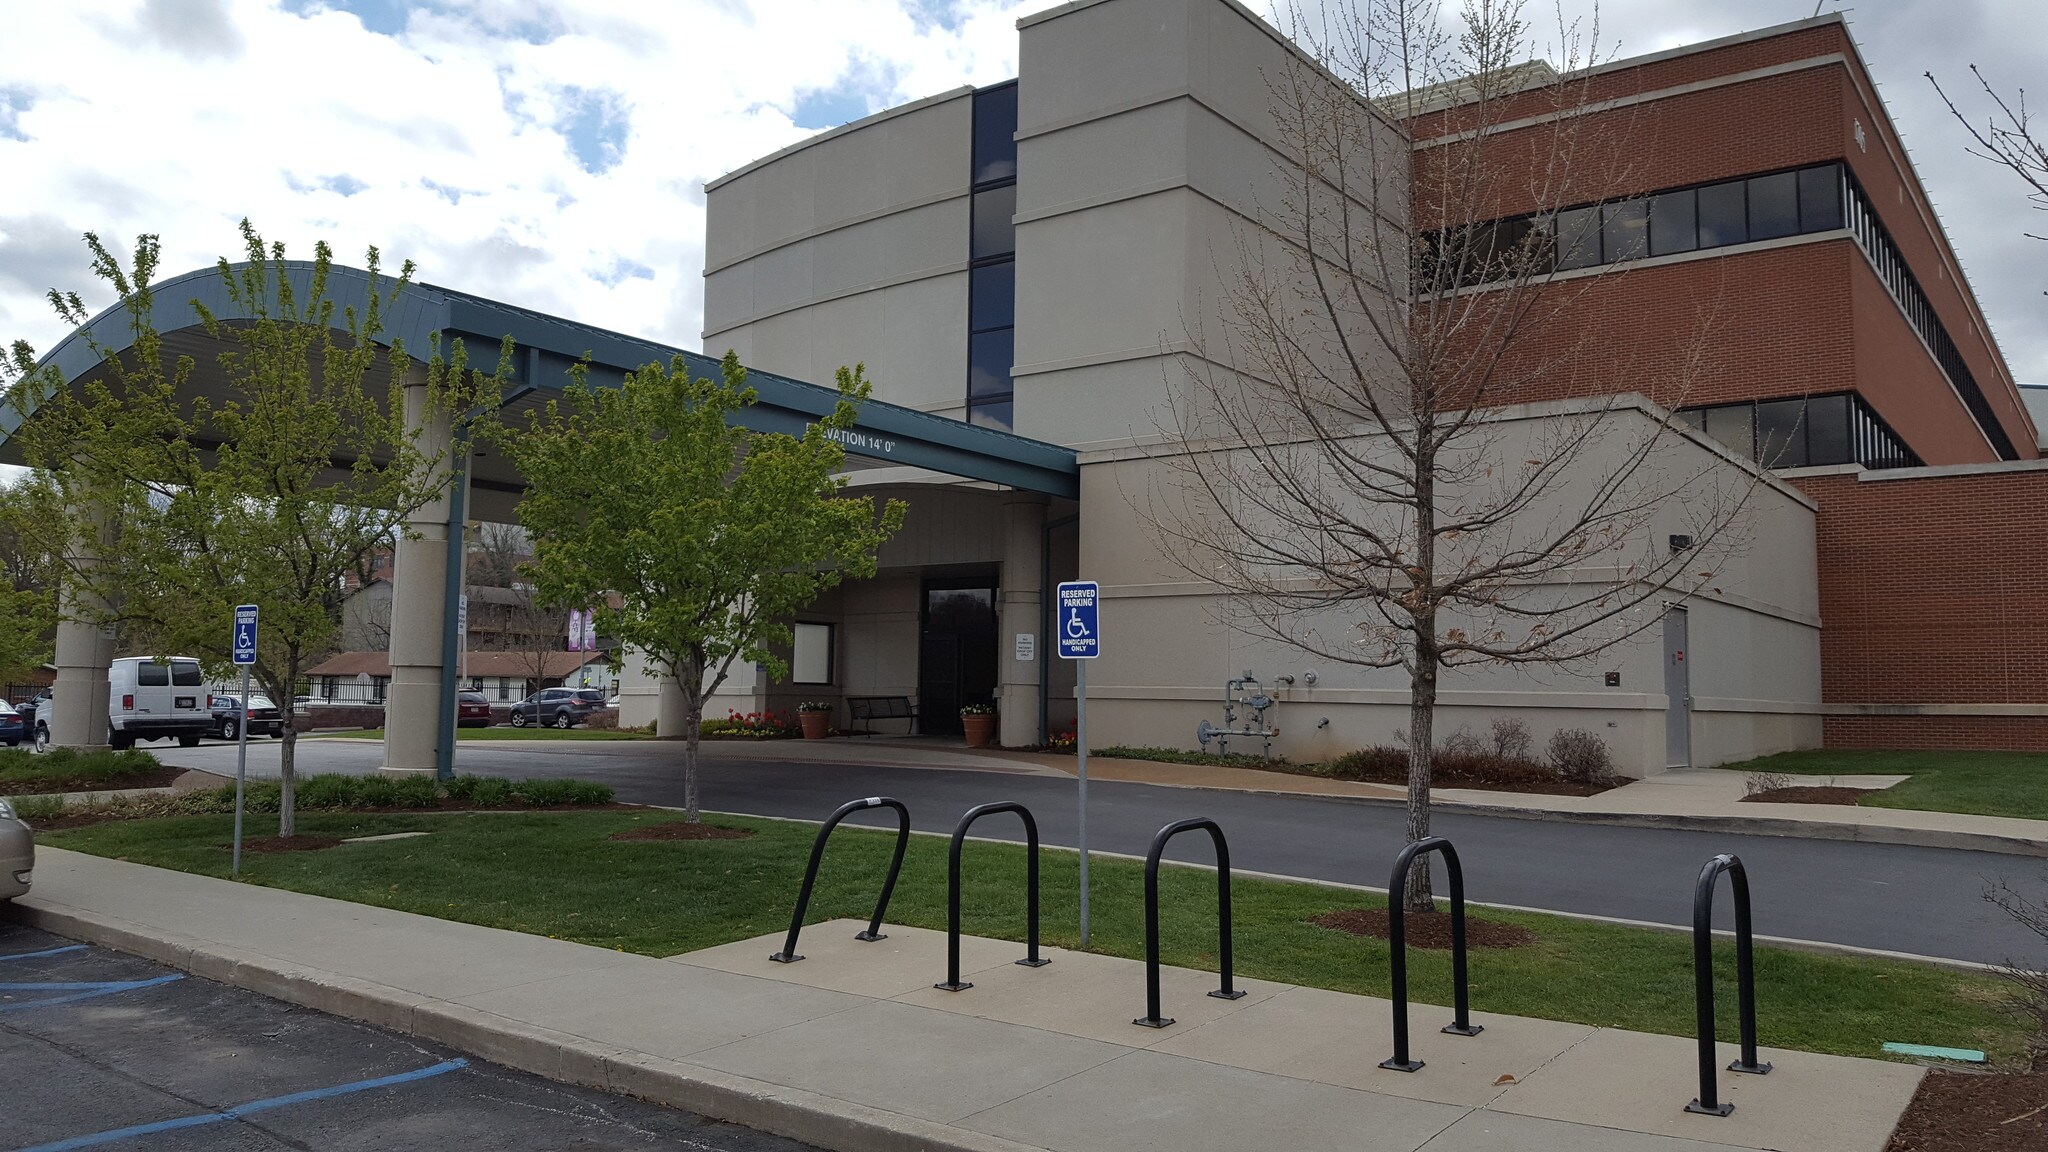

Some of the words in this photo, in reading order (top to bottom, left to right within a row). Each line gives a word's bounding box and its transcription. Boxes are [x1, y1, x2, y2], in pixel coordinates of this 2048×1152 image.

[868, 437, 883, 450] 14'
[1061, 589, 1095, 599] RESERVED
[1064, 598, 1093, 607] PARKING
[1062, 638, 1096, 646] HANDICAPPED
